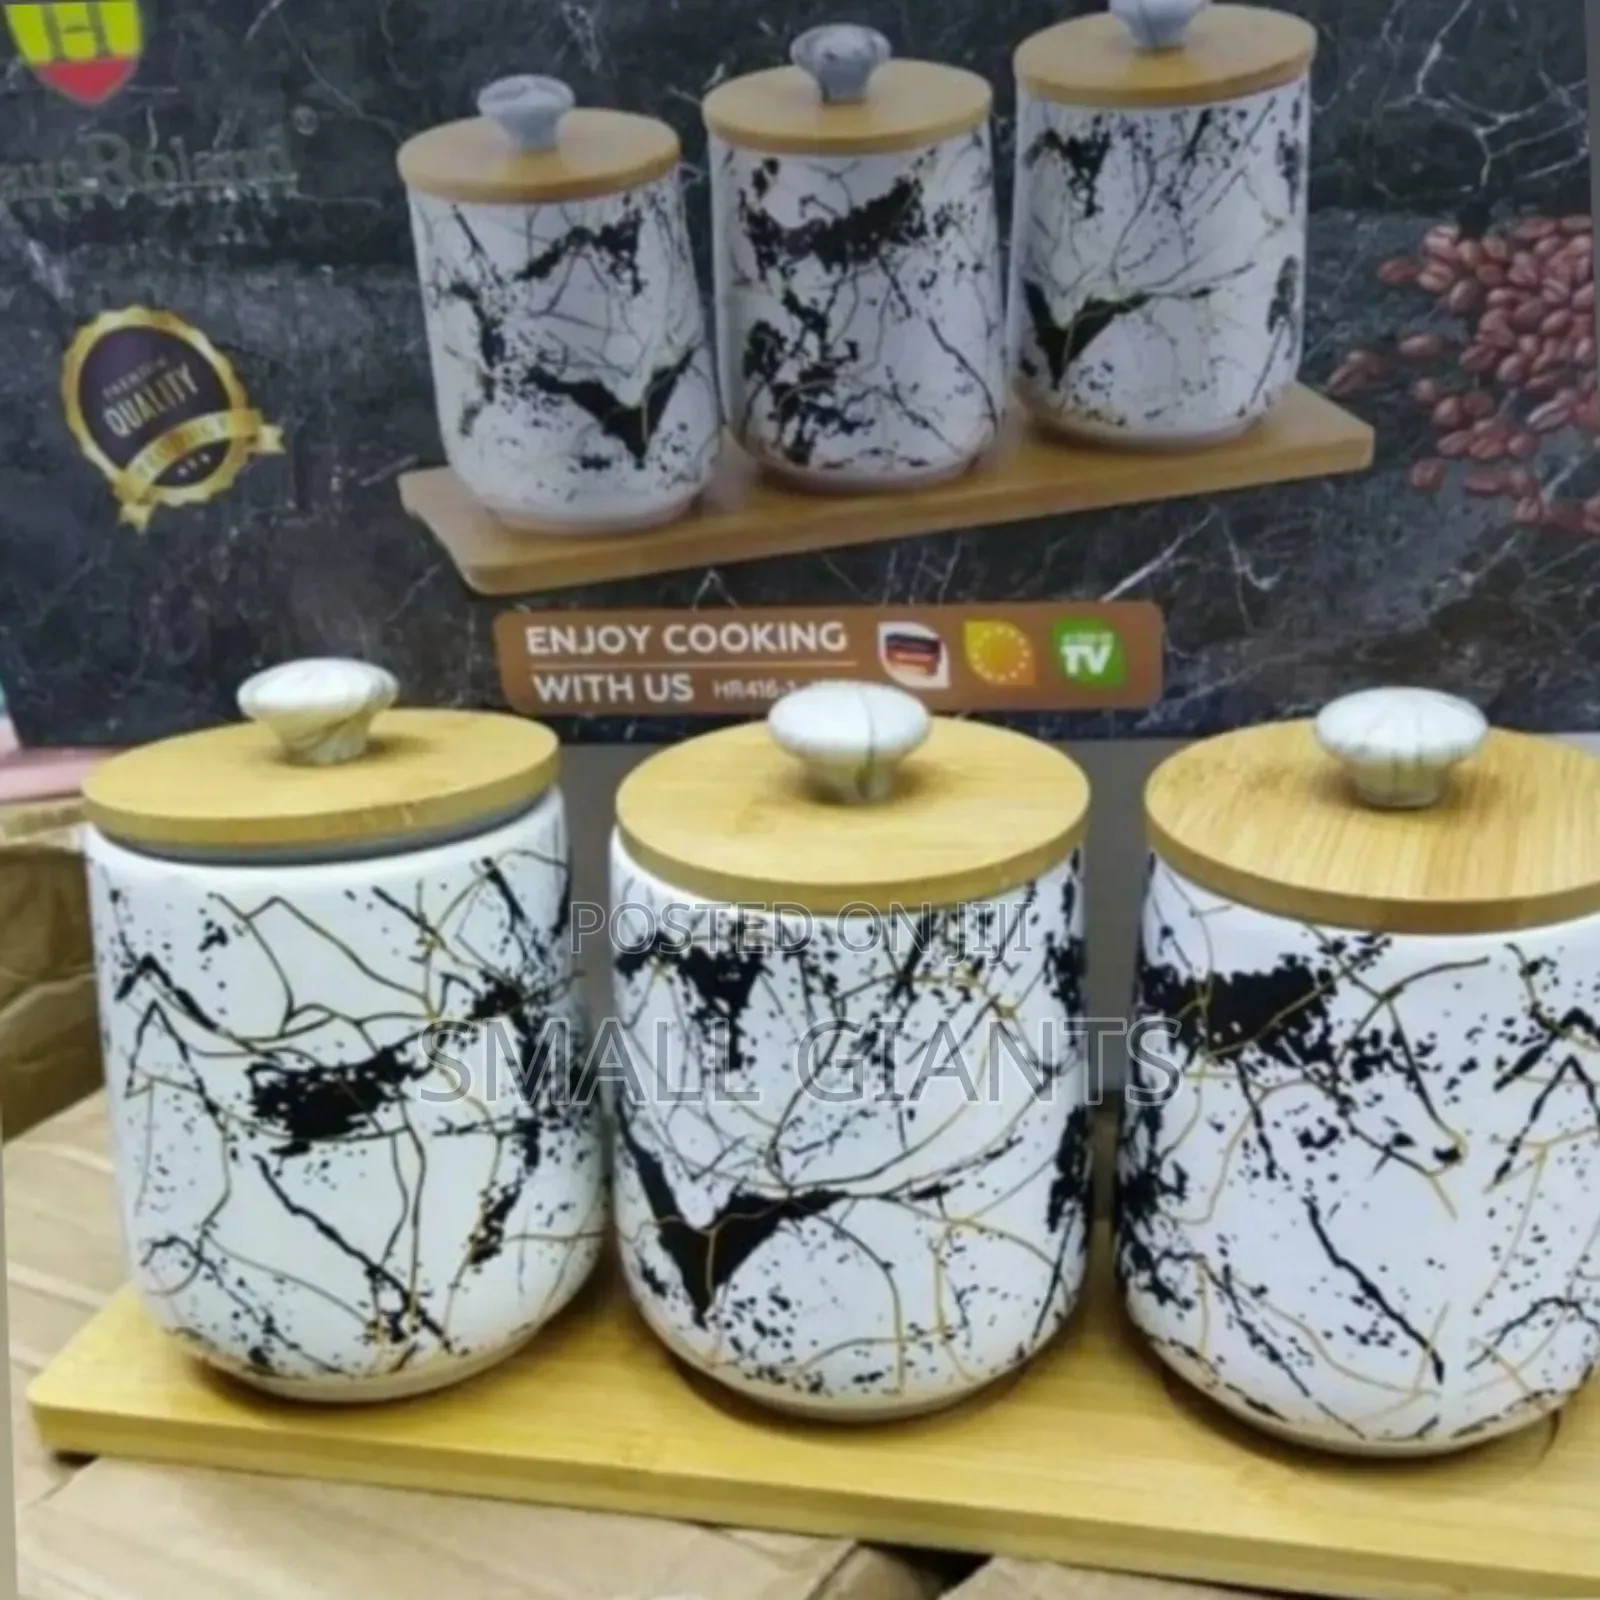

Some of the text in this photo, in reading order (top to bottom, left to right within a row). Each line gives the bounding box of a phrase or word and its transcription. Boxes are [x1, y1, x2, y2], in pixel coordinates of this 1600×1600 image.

[103, 361, 199, 438] QUALITY
[525, 621, 848, 656] ENJOY COOKING
[1060, 642, 1114, 677] TV
[533, 673, 695, 704] WITH US
